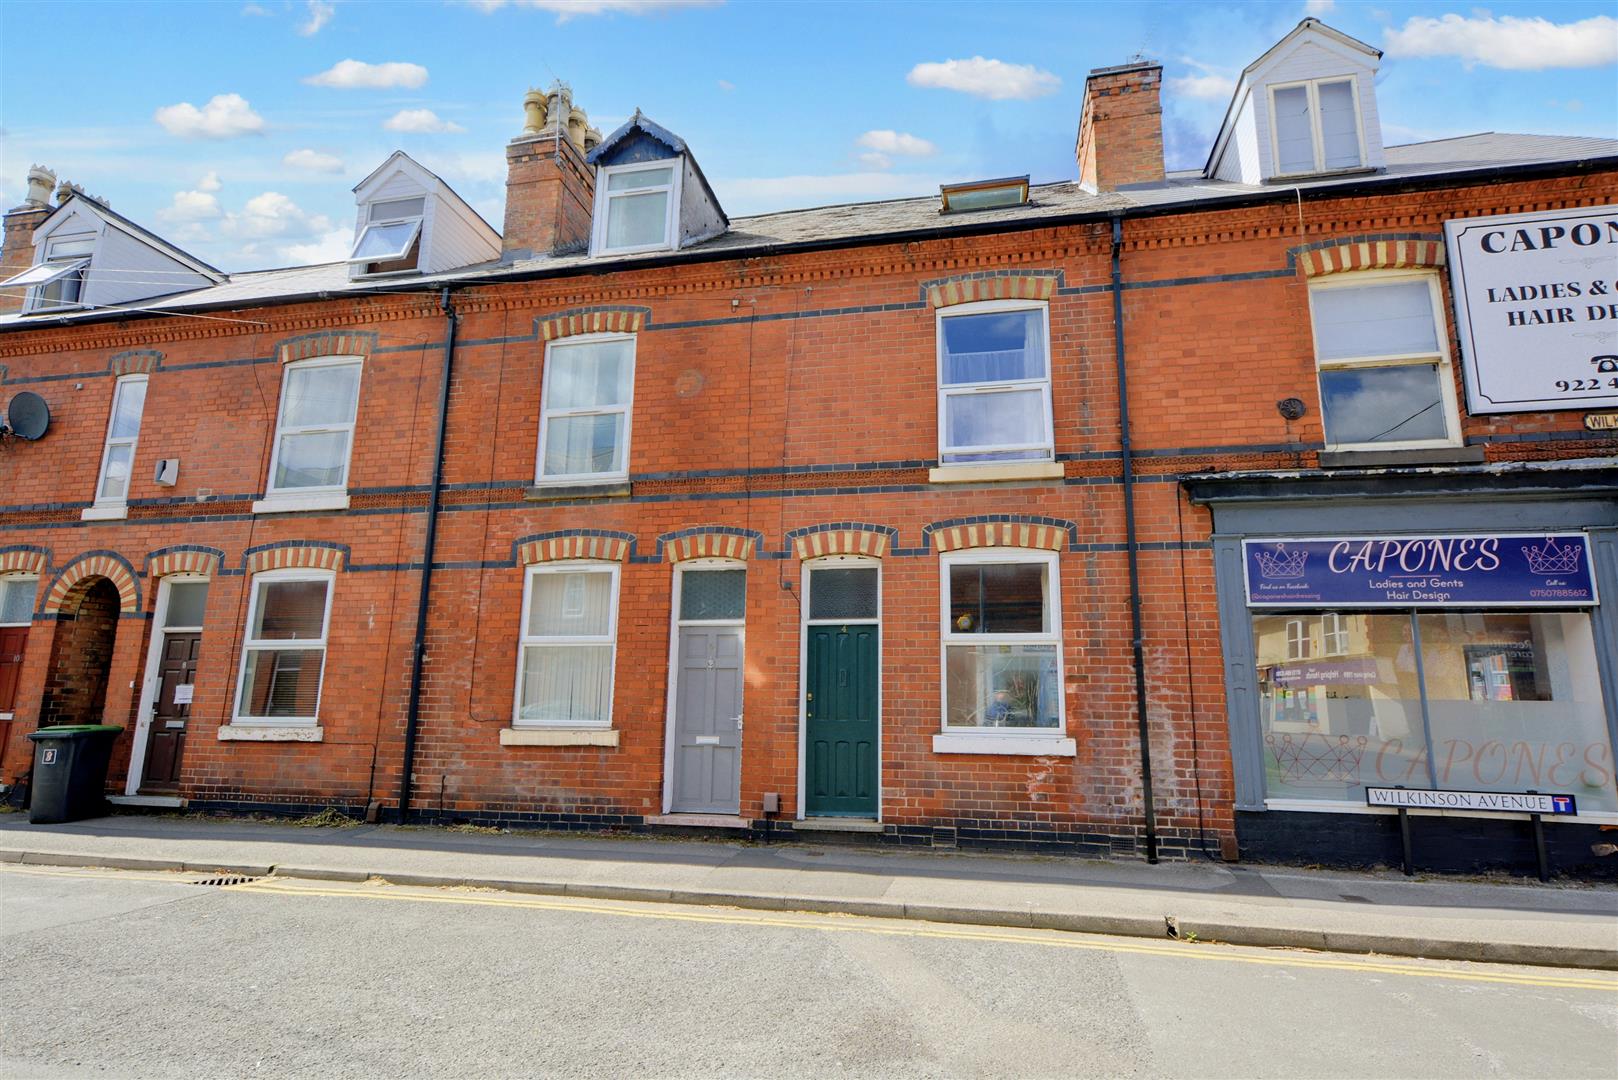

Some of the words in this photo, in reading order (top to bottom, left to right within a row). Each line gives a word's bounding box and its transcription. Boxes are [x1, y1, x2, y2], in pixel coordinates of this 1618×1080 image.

[1487, 282, 1582, 303] LADIES
[1588, 280, 1608, 296] &
[1506, 307, 1576, 327] HAIR
[1555, 378, 1601, 392] 922
[1328, 537, 1500, 574] CAPONES
[1369, 579, 1404, 589] Ladies
[1406, 579, 1427, 588] and
[1430, 578, 1464, 588] Gents
[1386, 590, 1409, 600] Hair
[1413, 590, 1450, 602] Design
[45, 751, 53, 762] 8
[1375, 738, 1610, 788] CAPONES
[1374, 790, 1472, 807] WILKINSON
[1478, 794, 1548, 810] AVENUE
